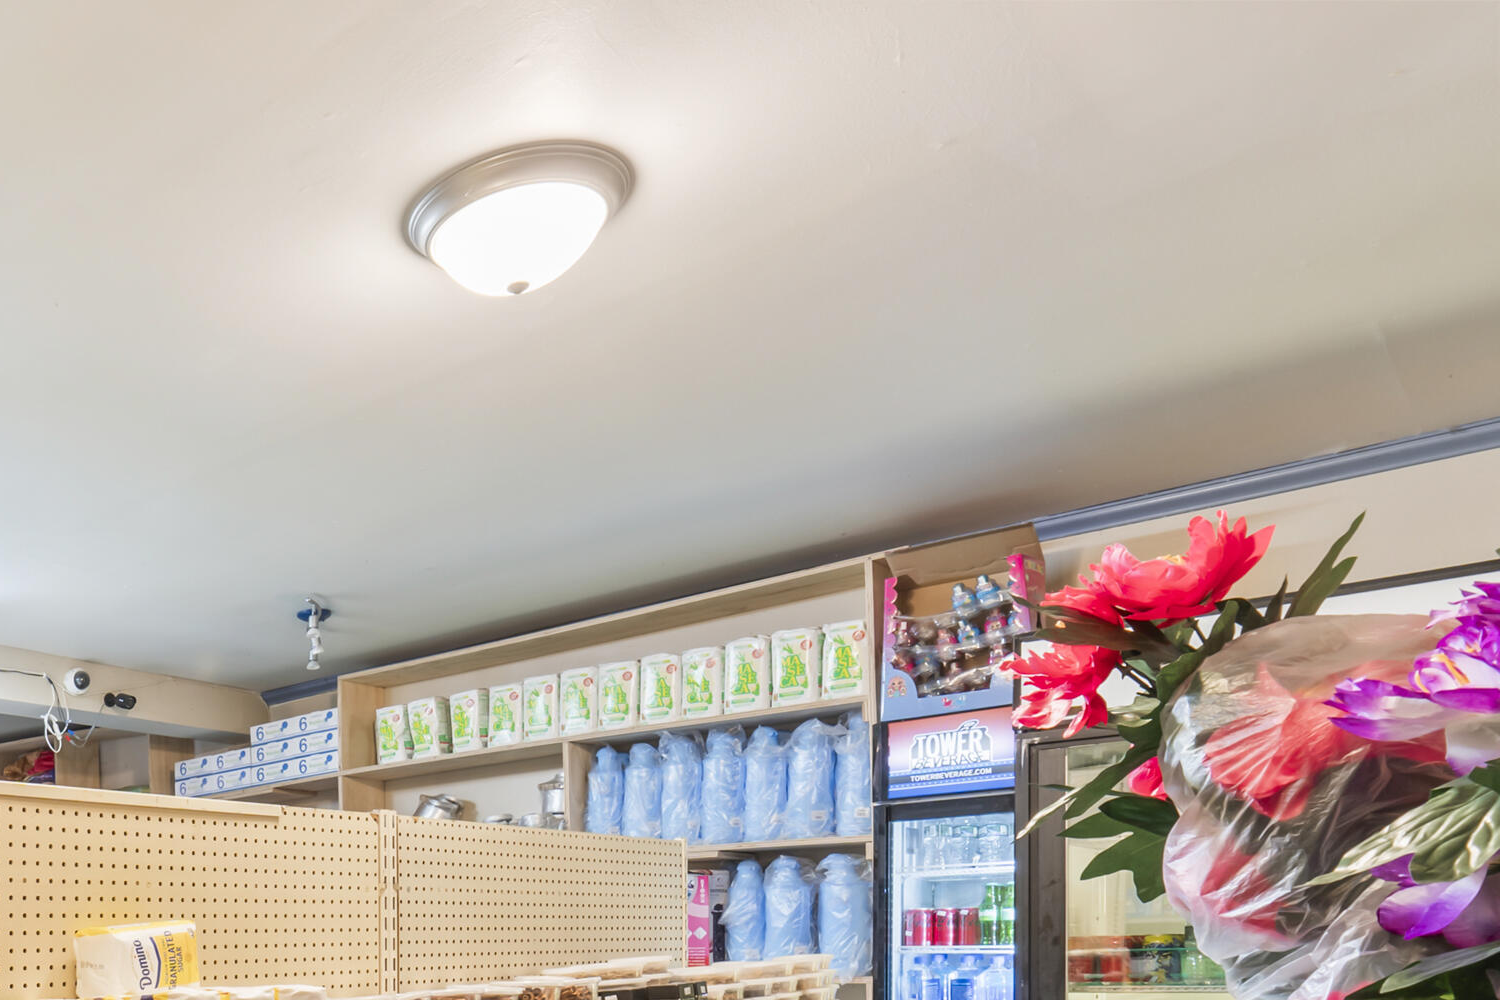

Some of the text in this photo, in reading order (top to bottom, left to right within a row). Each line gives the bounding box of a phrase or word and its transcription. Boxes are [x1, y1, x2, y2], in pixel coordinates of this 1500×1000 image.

[299, 717, 307, 731] 6
[256, 727, 264, 741] 6
[299, 738, 307, 752] 6
[914, 729, 984, 757] TOWER
[216, 755, 224, 768] 6
[257, 748, 264, 761] 6
[180, 762, 187, 776] 6
[299, 759, 307, 774] 6
[257, 767, 264, 782] 6
[910, 768, 992, 782] TOWERBEVERAGE.COM
[180, 782, 187, 795] 6
[217, 775, 224, 789] 6
[133, 940, 152, 990] Domino
